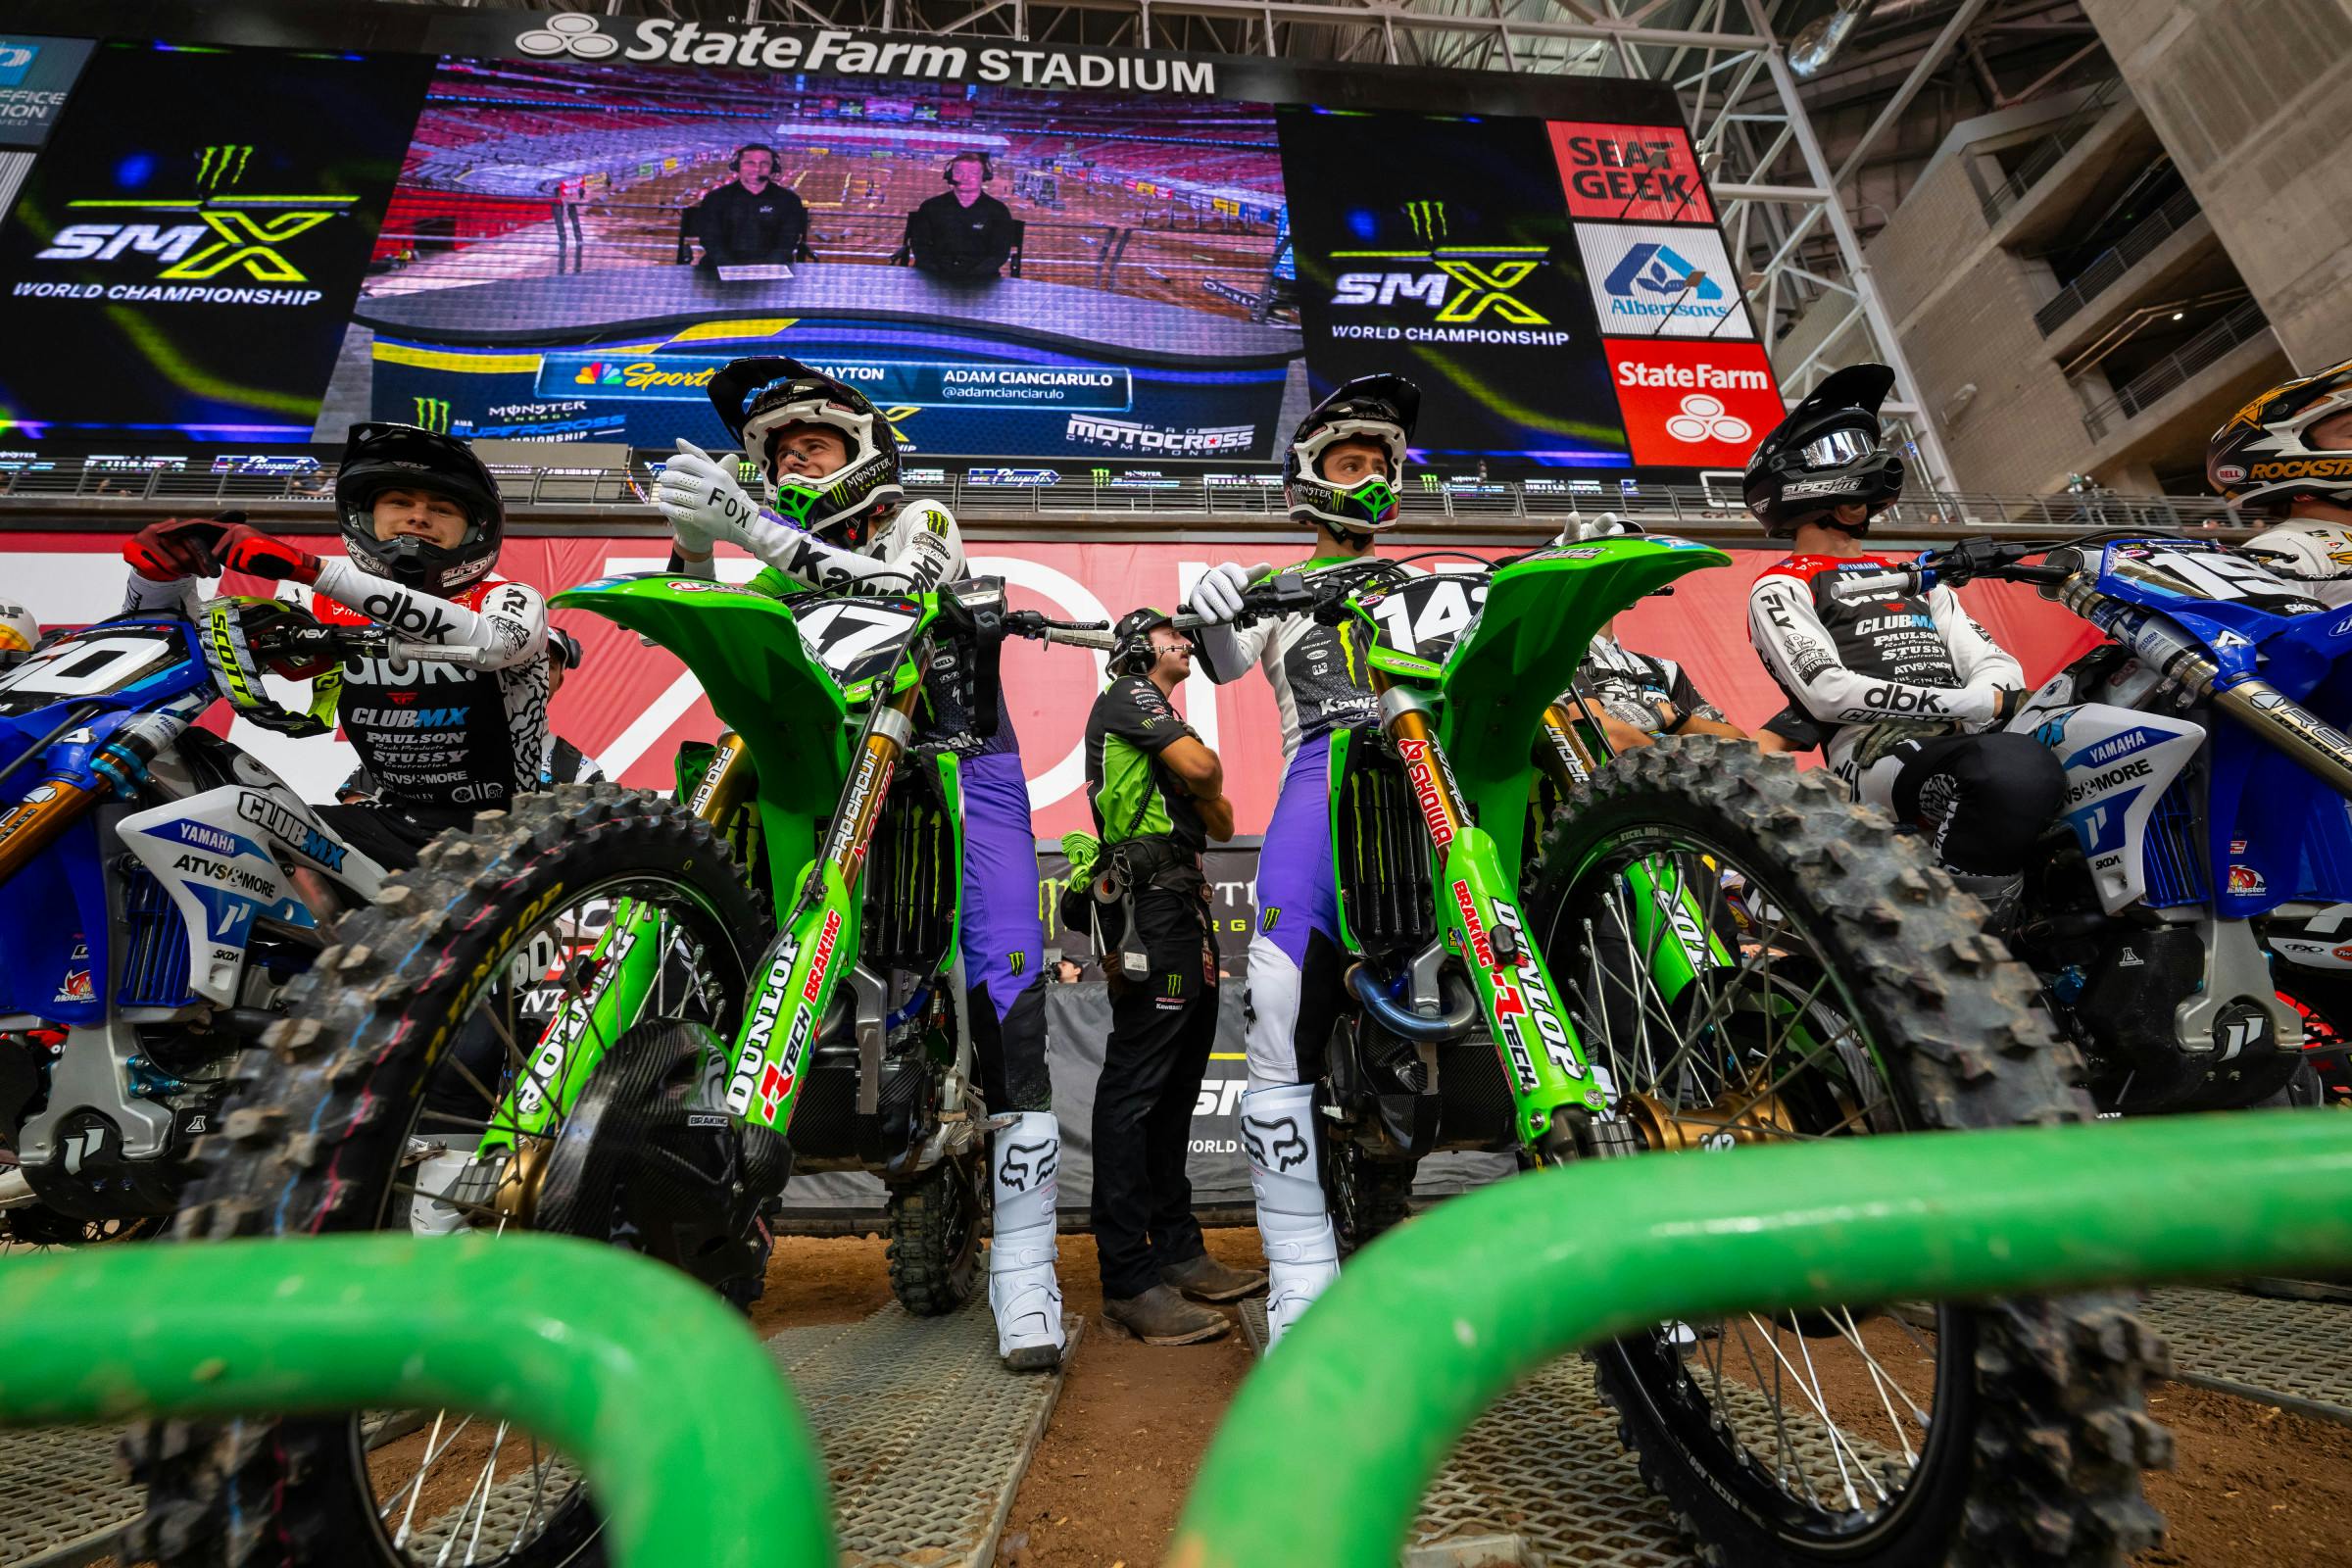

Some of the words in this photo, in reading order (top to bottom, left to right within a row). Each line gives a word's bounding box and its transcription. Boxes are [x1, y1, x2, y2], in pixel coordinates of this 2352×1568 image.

[978, 48, 1216, 94] STADIUM
[0, 104, 48, 118] ION
[1569, 136, 1675, 169] SEAT
[1572, 171, 1695, 206] GEEK
[13, 283, 100, 300] WORLD
[108, 285, 321, 306] CHAMPIONSHIP
[1611, 299, 1730, 319] Albertsons
[1332, 325, 1399, 340] WORLD
[1405, 326, 1570, 346] CHAMPIONSHIP
[944, 369, 996, 384] ADAM
[999, 370, 1113, 386] CIANCIARULO
[943, 386, 1064, 401] @adamcianciarulo
[489, 400, 587, 416] MONSTER
[504, 413, 572, 422] ENERGY
[450, 414, 627, 438] SUPERCROSS
[1066, 417, 1255, 451] MOTOCROSS
[1066, 434, 1251, 457] CHAMPIONSHIP
[846, 458, 892, 488] MONSTER
[2219, 469, 2240, 478] BELL
[1293, 482, 1332, 500] MONSTER
[707, 488, 752, 530] FOX
[1760, 594, 1795, 630] FLY
[296, 629, 328, 639] ASV
[212, 612, 253, 700] SCOTT
[934, 658, 953, 667] BELL
[1882, 645, 1946, 662] STUSSY
[351, 707, 470, 728] CLUBMX
[366, 731, 467, 744] PAULSON
[2089, 730, 2146, 763] YAMAHA
[372, 750, 470, 763] STUSSY
[847, 748, 881, 821] CIRCUIT
[1408, 761, 1454, 850] SHOWA
[180, 821, 236, 856] YAMAHA
[238, 792, 349, 873] CLUBMX
[173, 854, 276, 900] ATVS&MORE
[1452, 879, 1495, 969] BRAKING
[802, 908, 843, 1004] BRAKING
[726, 933, 802, 1116] DUNLOP
[689, 1114, 728, 1126] BRAKING
